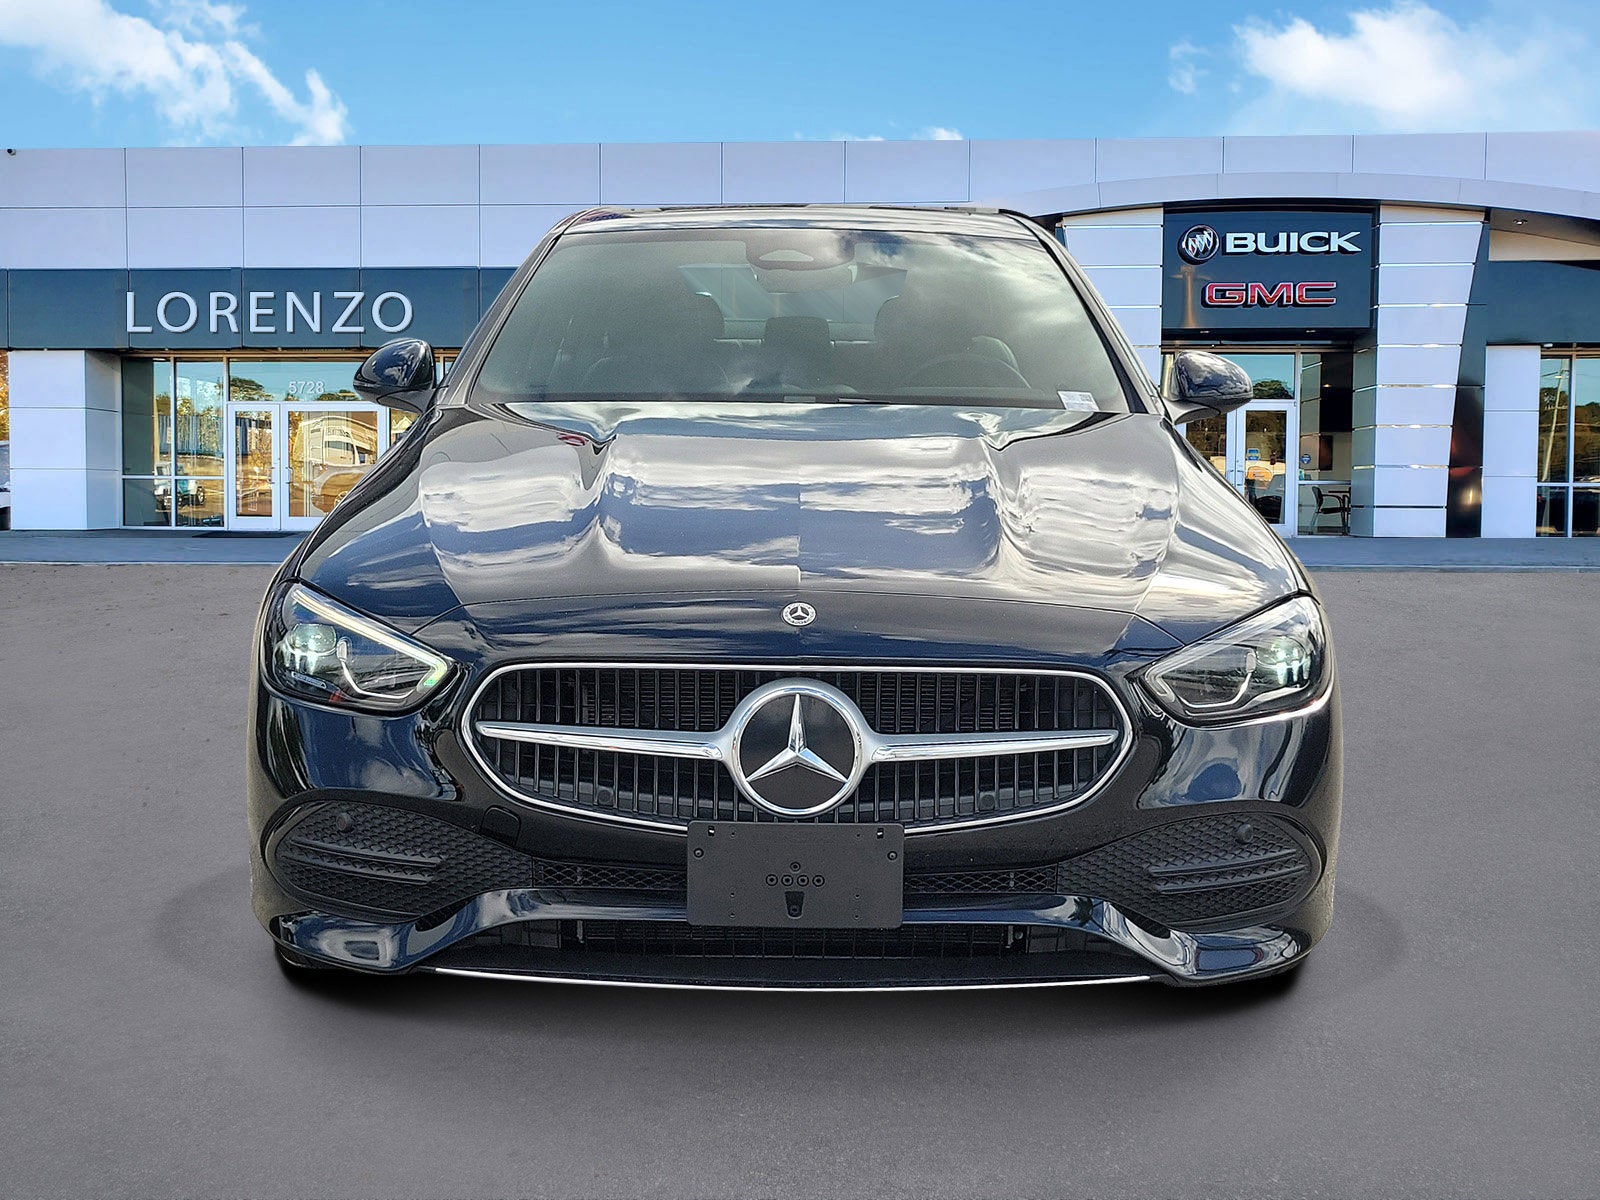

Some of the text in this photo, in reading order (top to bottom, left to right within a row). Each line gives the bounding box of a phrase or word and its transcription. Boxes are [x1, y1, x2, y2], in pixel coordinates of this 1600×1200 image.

[1226, 231, 1362, 252] BUICK
[1206, 282, 1337, 306] GMC
[126, 291, 414, 334] LORENZO
[288, 381, 325, 395] 5728
